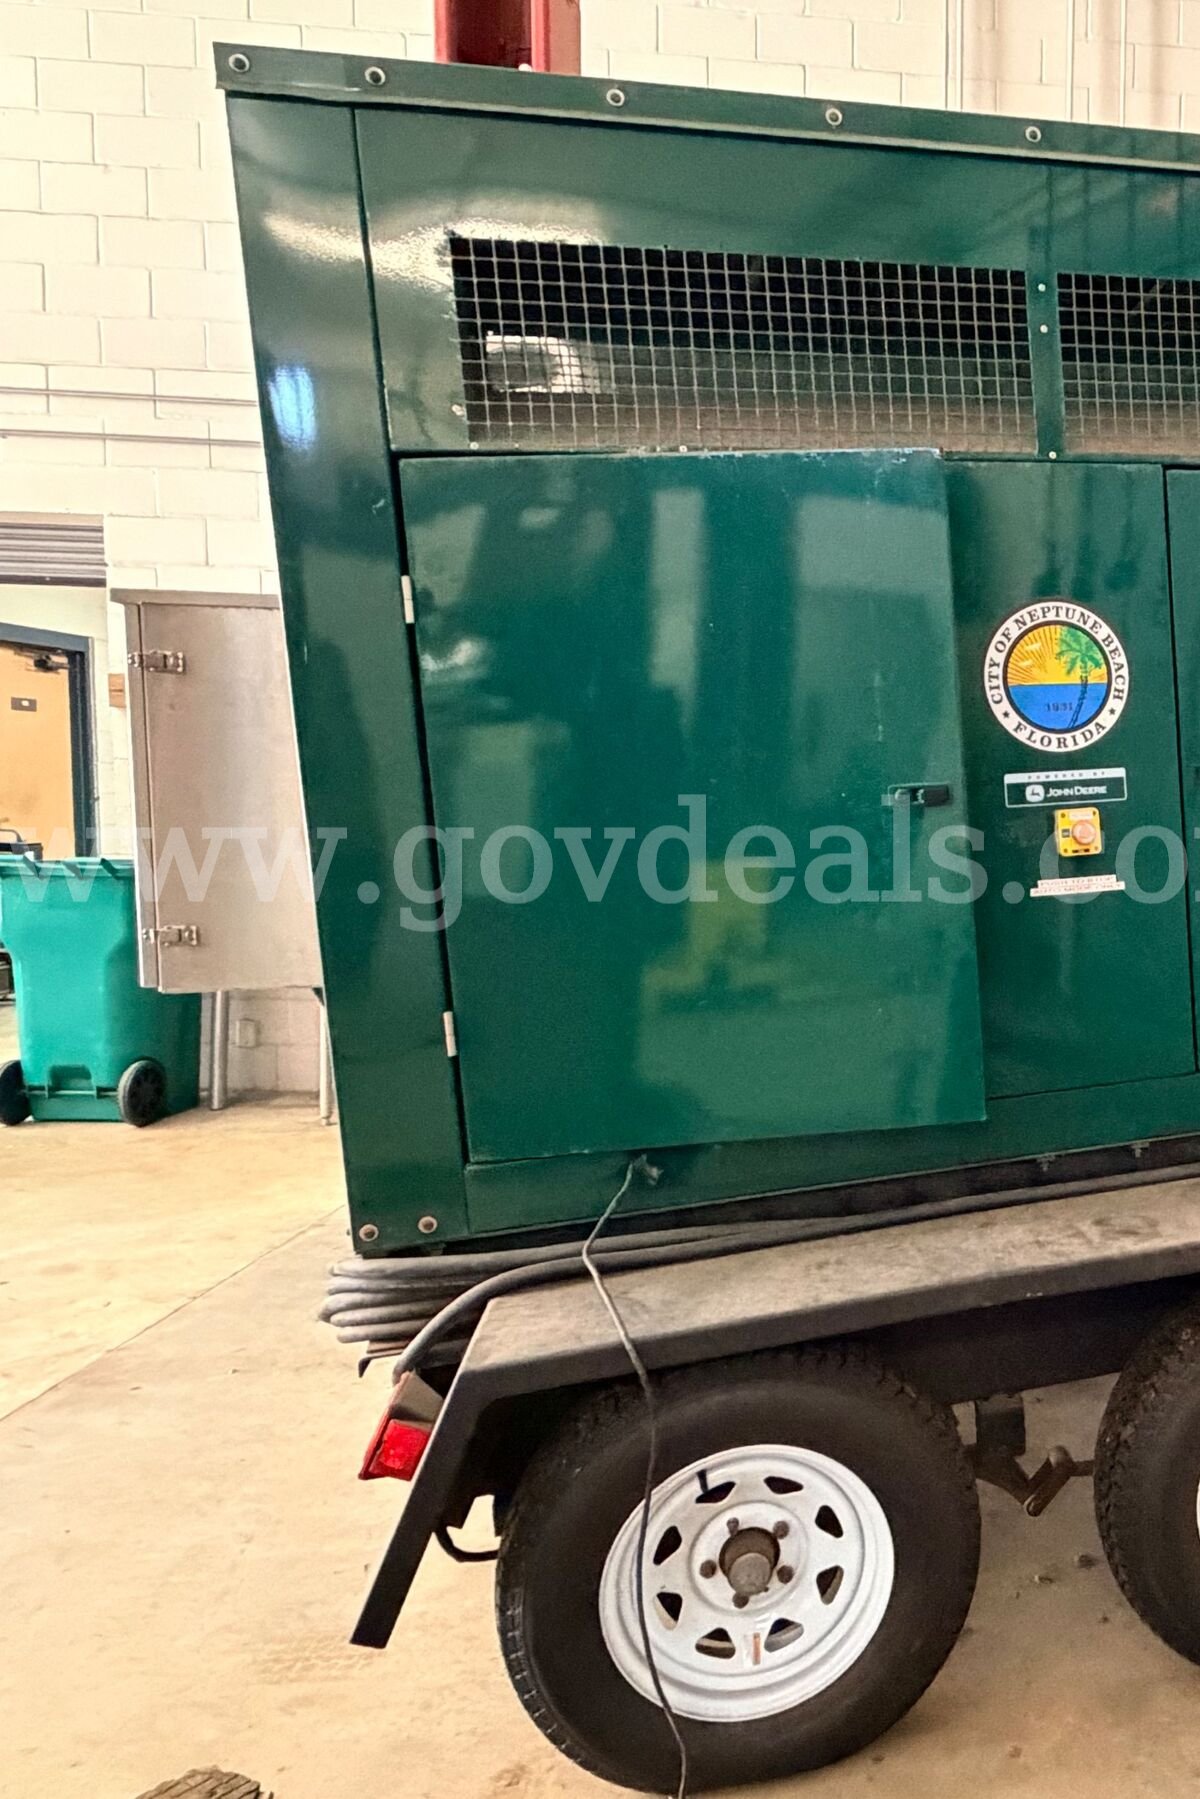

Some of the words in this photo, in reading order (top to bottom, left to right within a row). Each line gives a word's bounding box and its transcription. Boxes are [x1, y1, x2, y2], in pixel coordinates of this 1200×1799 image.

[1014, 605, 1103, 635] NEPTUNE
[994, 627, 1012, 654] OF
[988, 657, 1003, 705] CITY
[1102, 633, 1126, 701] BEACH
[1013, 721, 1107, 749] FLORIDA
[1046, 787, 1074, 798] JOHN
[1074, 785, 1107, 796] DEERE
